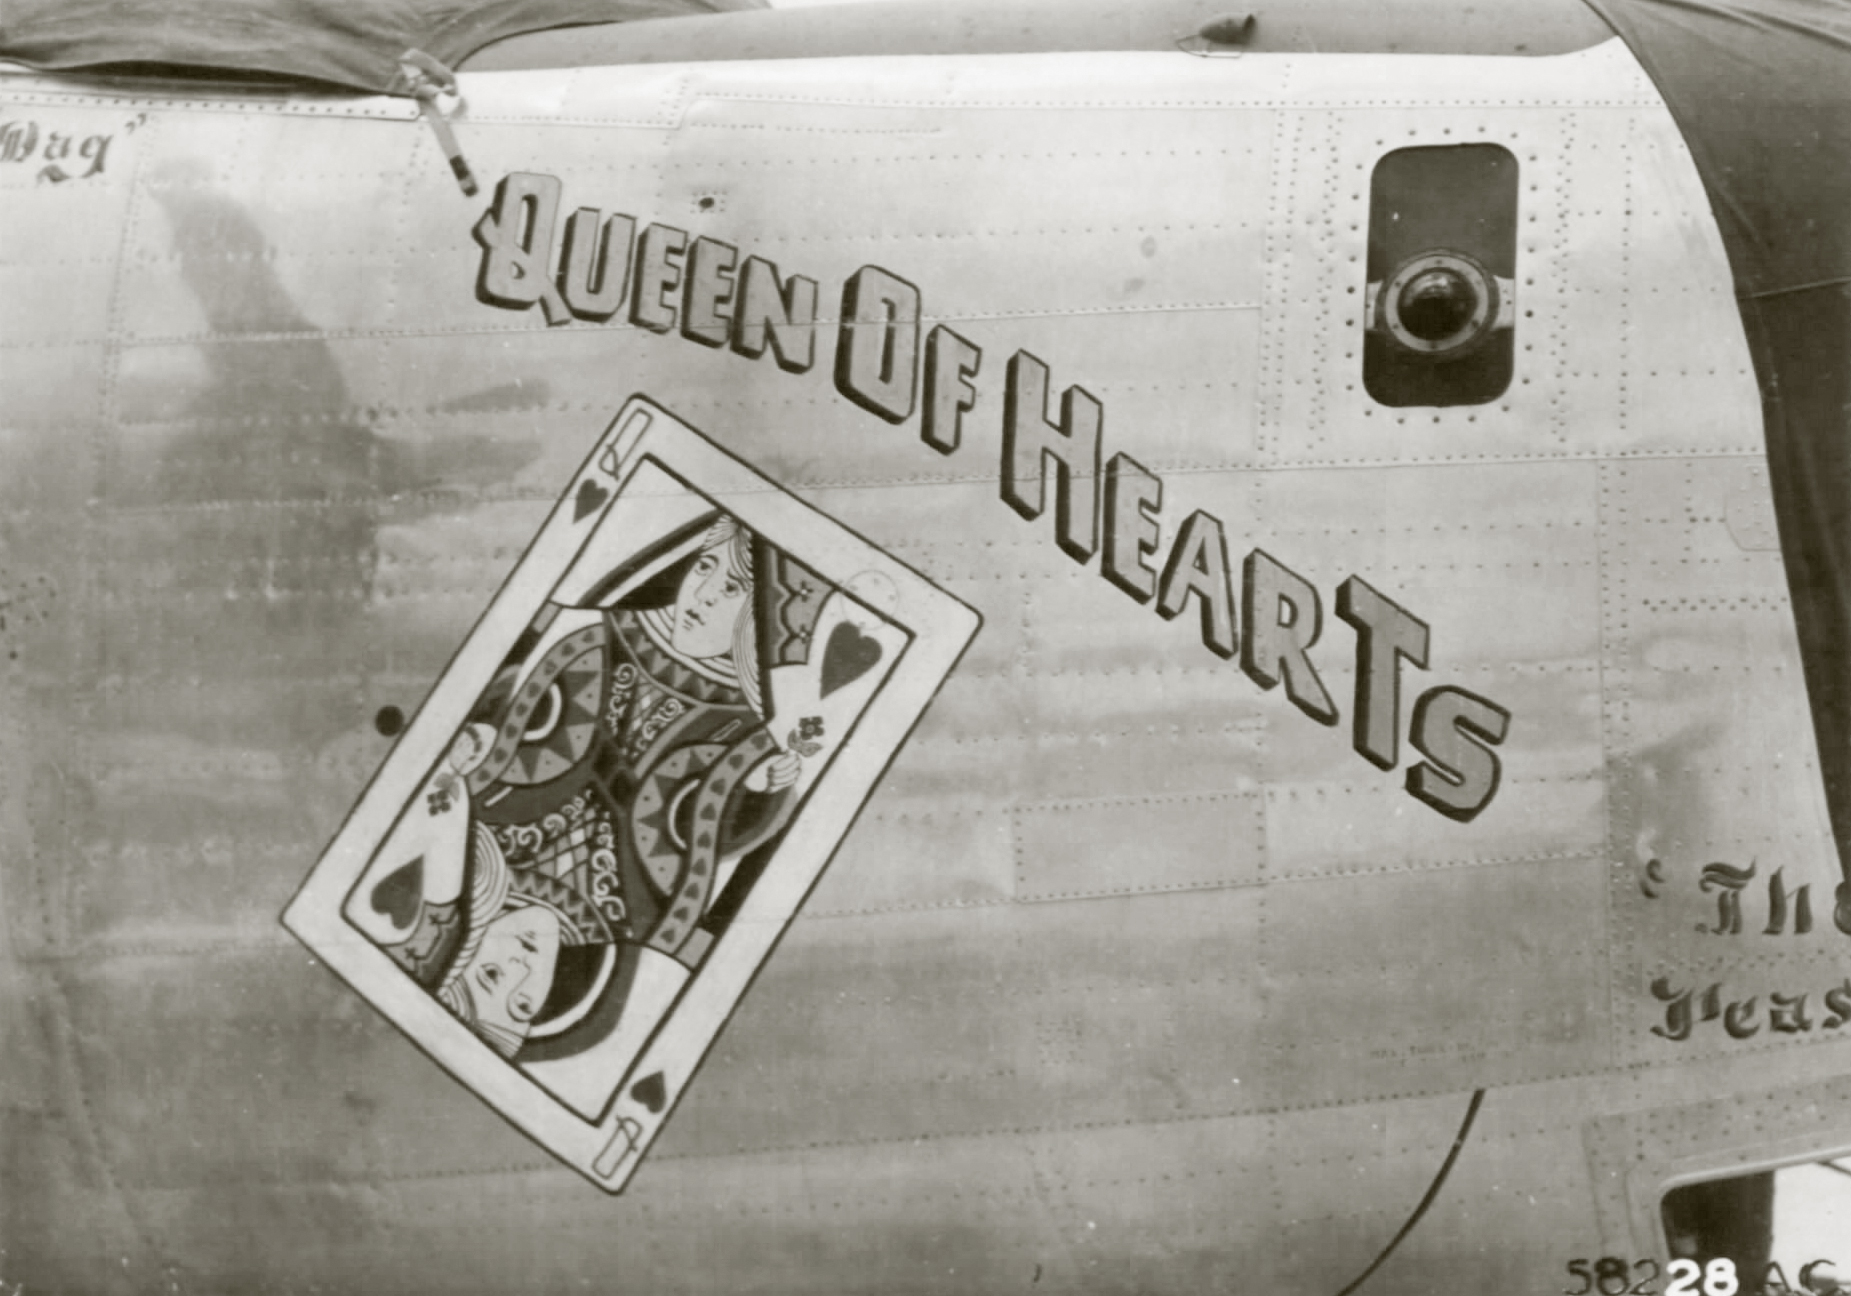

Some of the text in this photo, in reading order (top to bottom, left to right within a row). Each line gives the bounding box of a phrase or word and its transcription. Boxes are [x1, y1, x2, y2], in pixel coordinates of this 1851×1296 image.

[471, 171, 1512, 824] QUEEN OF HEARTS
